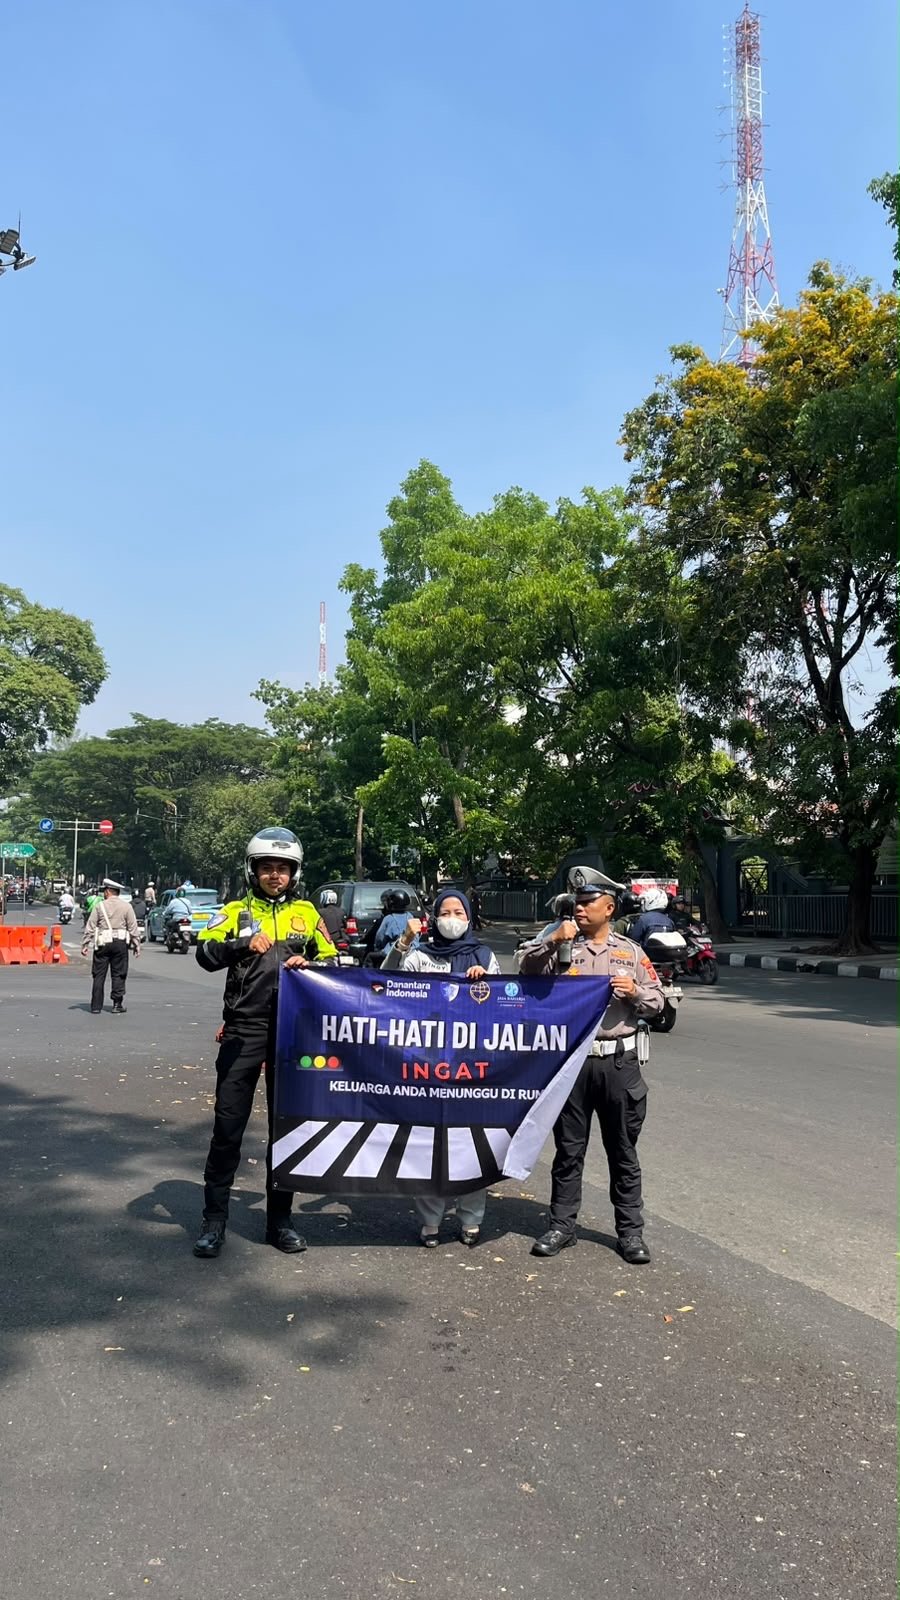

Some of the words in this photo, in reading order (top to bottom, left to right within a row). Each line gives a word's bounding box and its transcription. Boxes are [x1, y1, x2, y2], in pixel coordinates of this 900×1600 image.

[421, 960, 446, 971] WINDY
[609, 959, 634, 967] POLRI
[386, 980, 431, 989] Danantara
[386, 989, 428, 998] Indonesia
[322, 1015, 445, 1048] HATI-HATI
[452, 1021, 477, 1050] DI
[483, 1023, 567, 1052] JALAN
[402, 1061, 489, 1080] INGAT
[329, 1080, 391, 1096] KELUARGA
[392, 1085, 427, 1098] ANDA
[429, 1087, 498, 1100] MENUNGGU
[501, 1088, 516, 1100] DI
